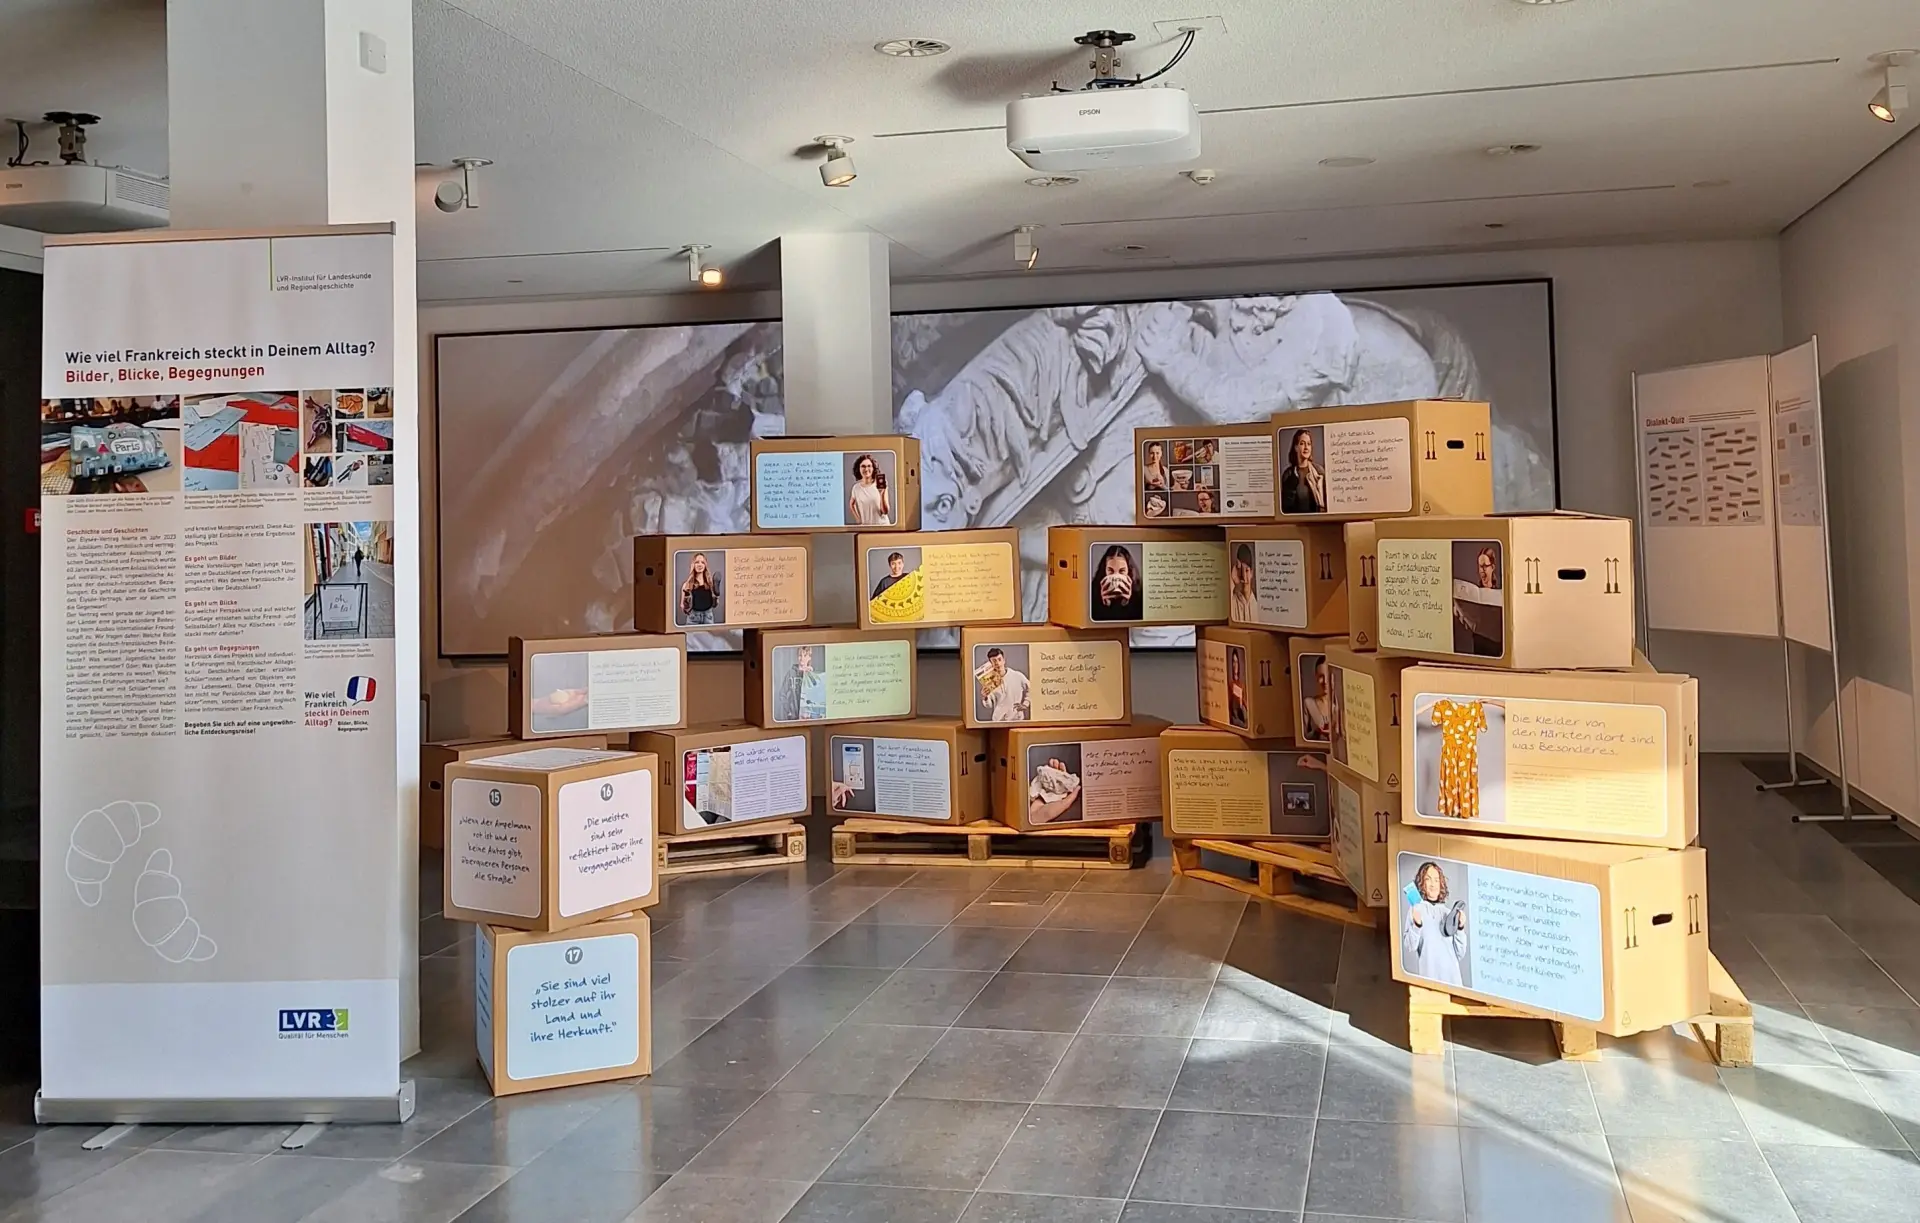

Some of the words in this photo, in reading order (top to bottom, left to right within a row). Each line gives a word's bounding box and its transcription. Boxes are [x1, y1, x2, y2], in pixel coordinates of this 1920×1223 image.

[277, 274, 314, 282] LVR-Institut
[291, 282, 354, 292] Regionalgeschichte
[66, 352, 92, 363] Wie
[96, 351, 121, 362] viel
[126, 348, 200, 361] Frankreich
[204, 346, 247, 359] steckt
[251, 345, 263, 357] in
[268, 344, 321, 356] Deinem
[326, 341, 375, 356] Alltag?
[66, 370, 113, 383] Bilder,
[119, 368, 164, 380] Blicke,
[169, 366, 264, 381] Begegnungen
[1646, 416, 1685, 427] Dialekt-Quiz
[115, 440, 140, 452] Paris
[1040, 652, 1056, 660] Das
[1069, 664, 1105, 675] Lieblings-
[1088, 674, 1096, 683] ich
[1042, 702, 1065, 711] Josef,
[305, 719, 332, 727] Alltag?
[1512, 714, 1531, 723] Die
[1536, 715, 1580, 726] Kleider
[1586, 720, 1606, 728] von
[1512, 728, 1536, 736] den
[1540, 729, 1591, 741] Märkten
[1595, 733, 1625, 742] dort
[1631, 736, 1655, 744] sind
[1539, 742, 1618, 756] Besonderes.
[490, 791, 500, 804] 15
[601, 786, 612, 799] 16
[481, 817, 493, 827] der
[495, 819, 532, 831] Ampelmann
[602, 813, 629, 823] meisten
[473, 831, 483, 839] rot
[484, 831, 493, 840] ist
[495, 833, 507, 843] und
[590, 831, 606, 842] sind
[608, 828, 624, 838] sehr
[468, 842, 486, 854] keine
[488, 846, 506, 857] Autos
[569, 845, 609, 860] reflektiert
[611, 841, 627, 852] über
[629, 837, 643, 848] ihre
[461, 856, 499, 869] überqueren
[501, 859, 530, 873] Personen
[475, 872, 485, 881] die
[1477, 878, 1488, 887] Die
[1491, 881, 1551, 900] Kommunikation
[1553, 892, 1574, 903] beim
[1513, 900, 1529, 908] war
[1532, 903, 1544, 911] ein
[1534, 917, 1561, 928] unsere
[1516, 936, 1532, 947] Aber
[1552, 943, 1579, 957] haben
[567, 948, 581, 962] 17
[564, 979, 587, 989] sind
[591, 973, 611, 984] viel
[531, 996, 570, 1010] stolzer
[575, 992, 596, 1004] auf
[600, 991, 616, 1001] ihr
[283, 1012, 321, 1028] LVR
[545, 1012, 575, 1024] Land
[580, 1009, 602, 1019] und
[530, 1032, 554, 1042] ihre
